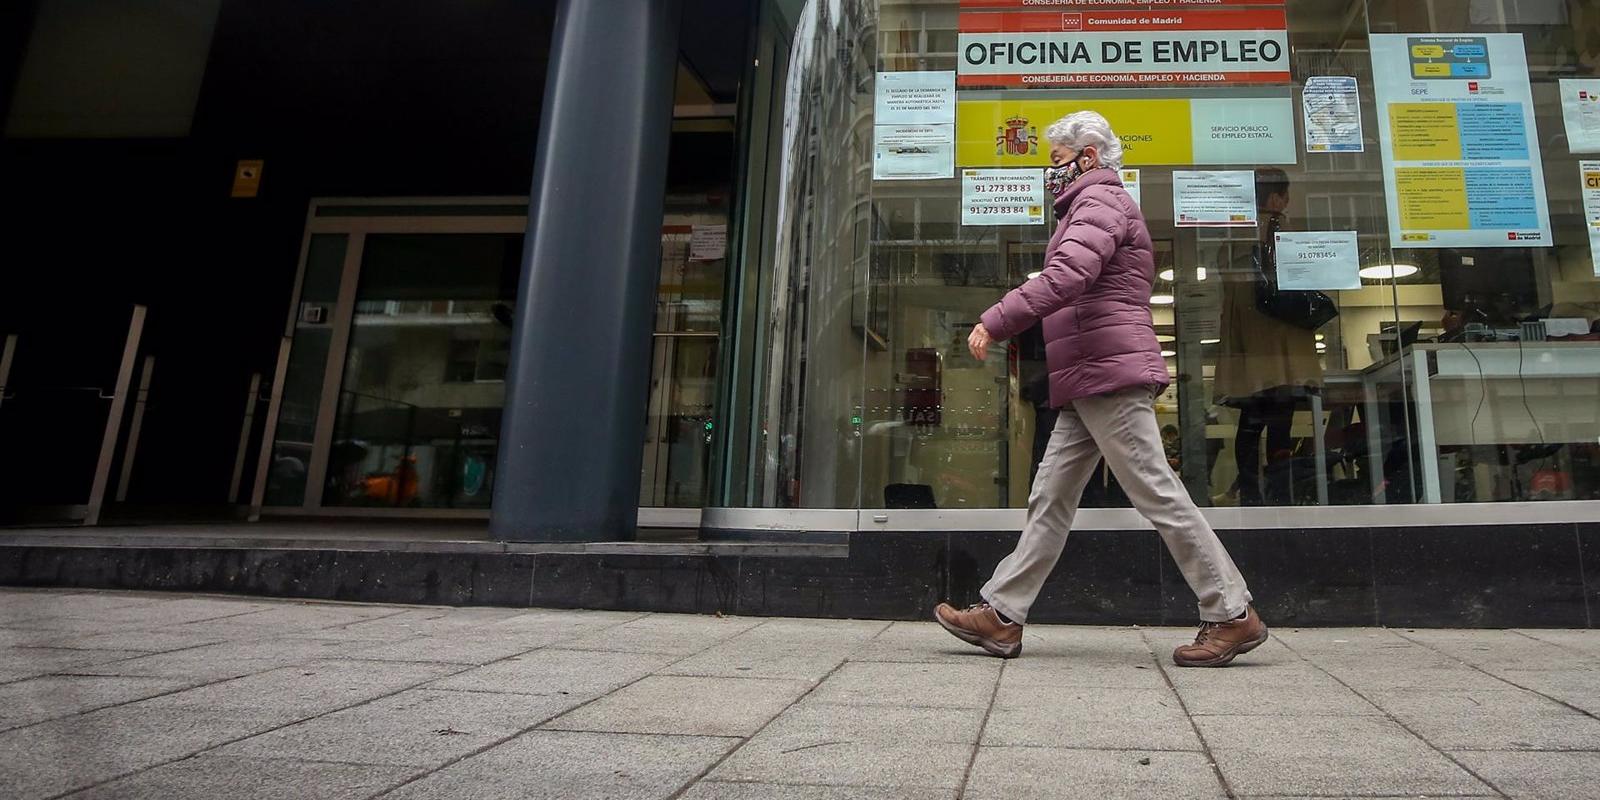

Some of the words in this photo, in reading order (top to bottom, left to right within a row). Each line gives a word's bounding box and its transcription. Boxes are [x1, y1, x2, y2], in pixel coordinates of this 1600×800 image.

[1088, 17, 1137, 25] Comunidad
[964, 41, 1092, 65] OFICINA
[1101, 41, 1143, 64] DE
[1152, 39, 1282, 63] EMPLEO
[1022, 74, 1075, 83] CONSEJERÍA
[1089, 73, 1137, 82] ECONOMÍA,
[1139, 74, 1174, 82] EMPLEO
[975, 184, 986, 192] 91
[989, 184, 1004, 192] 273
[1007, 184, 1018, 192] 83
[1020, 184, 1031, 192] 83
[983, 206, 998, 214] 273
